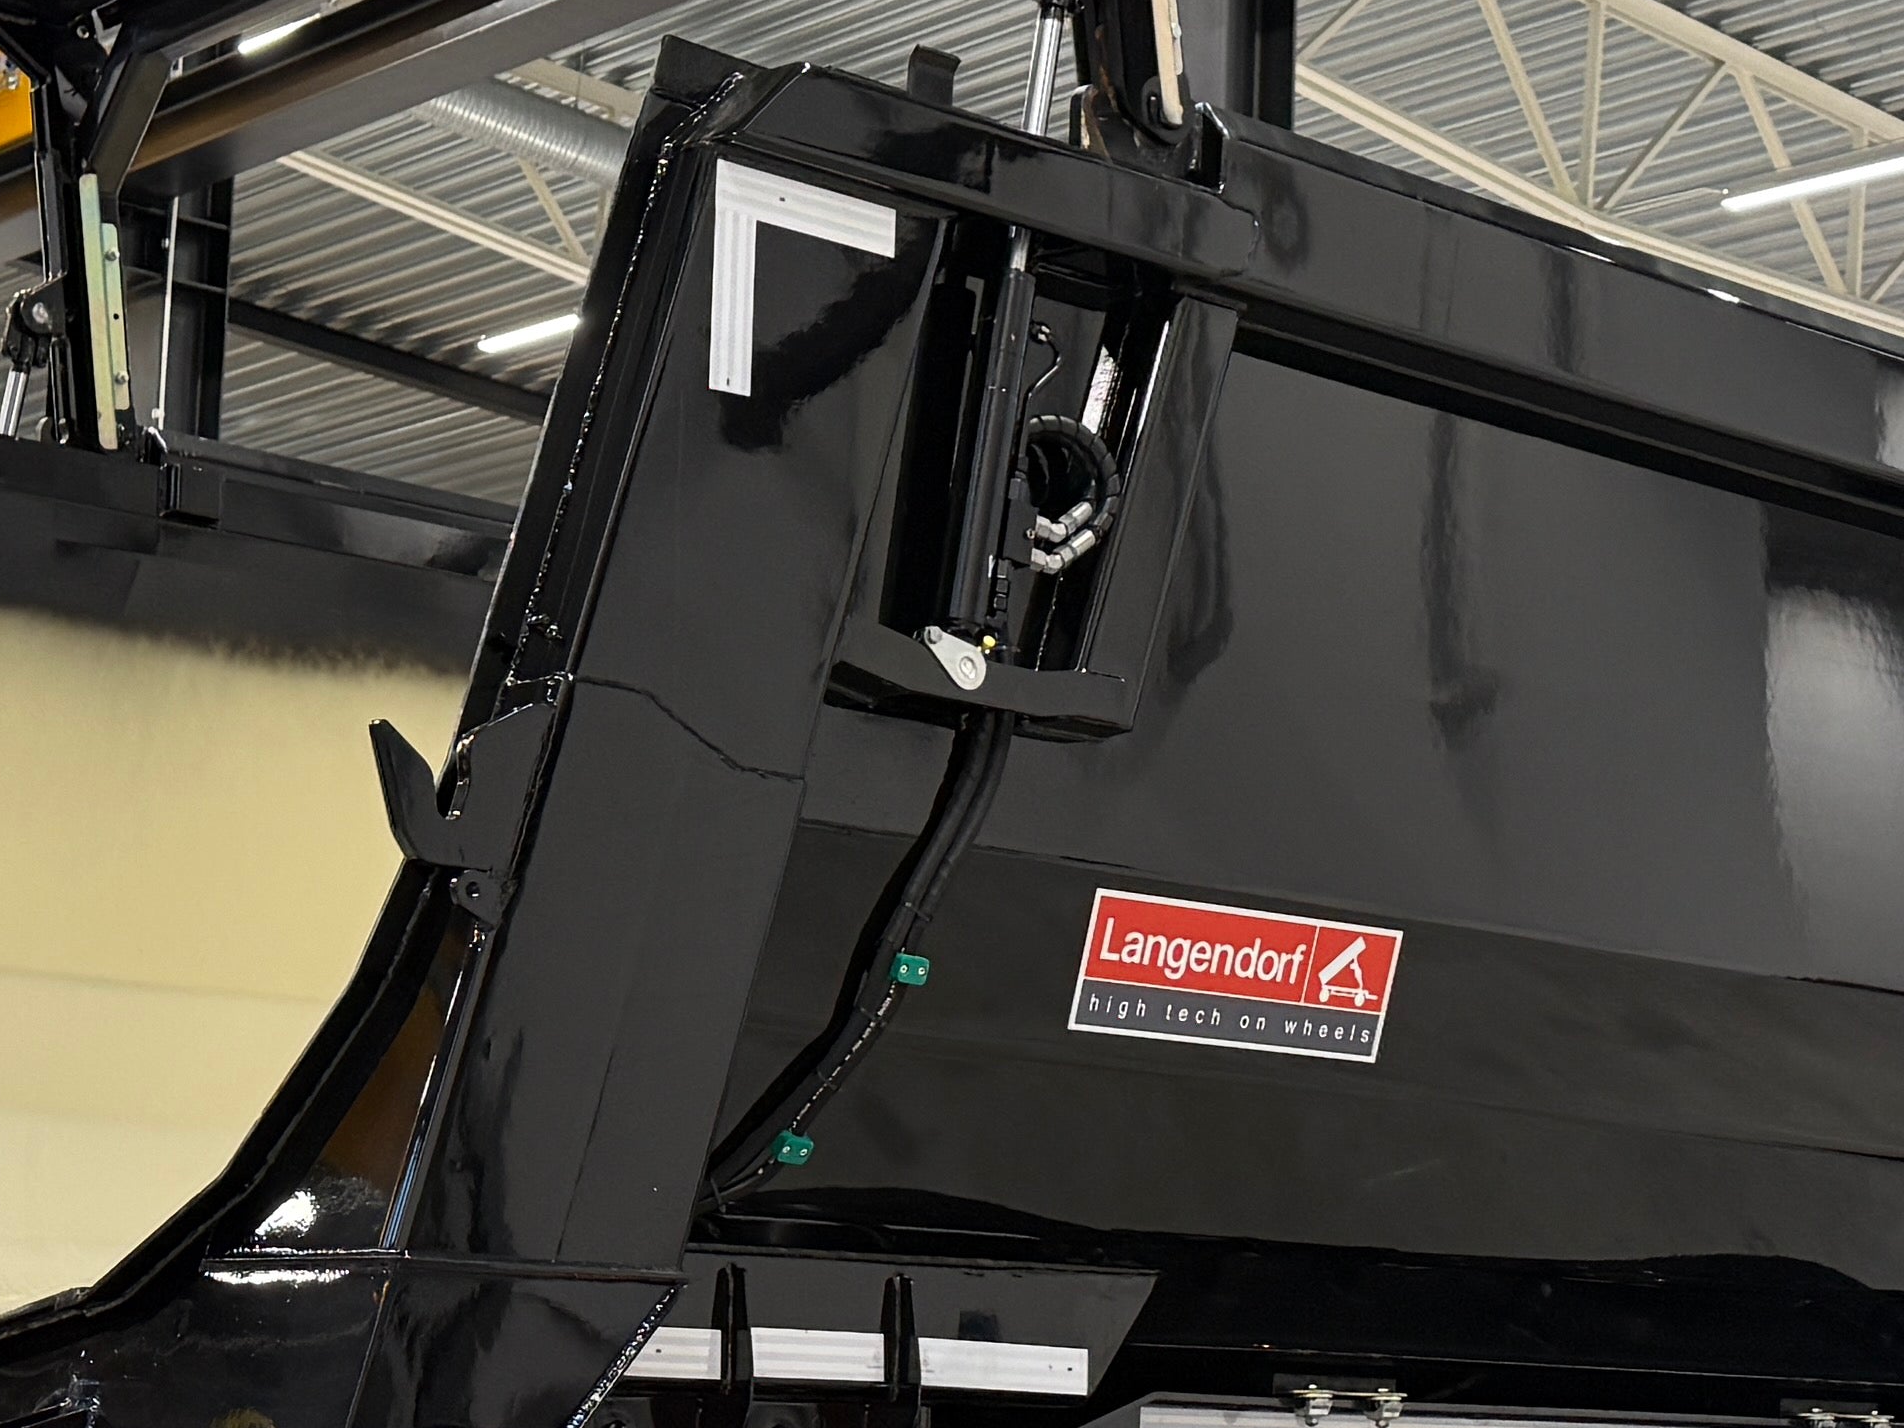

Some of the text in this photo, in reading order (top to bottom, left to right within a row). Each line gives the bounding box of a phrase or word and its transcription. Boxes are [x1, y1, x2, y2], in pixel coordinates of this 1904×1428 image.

[1099, 917, 1307, 984] Langendorf
[1088, 994, 1372, 1043] high tech on wheels
